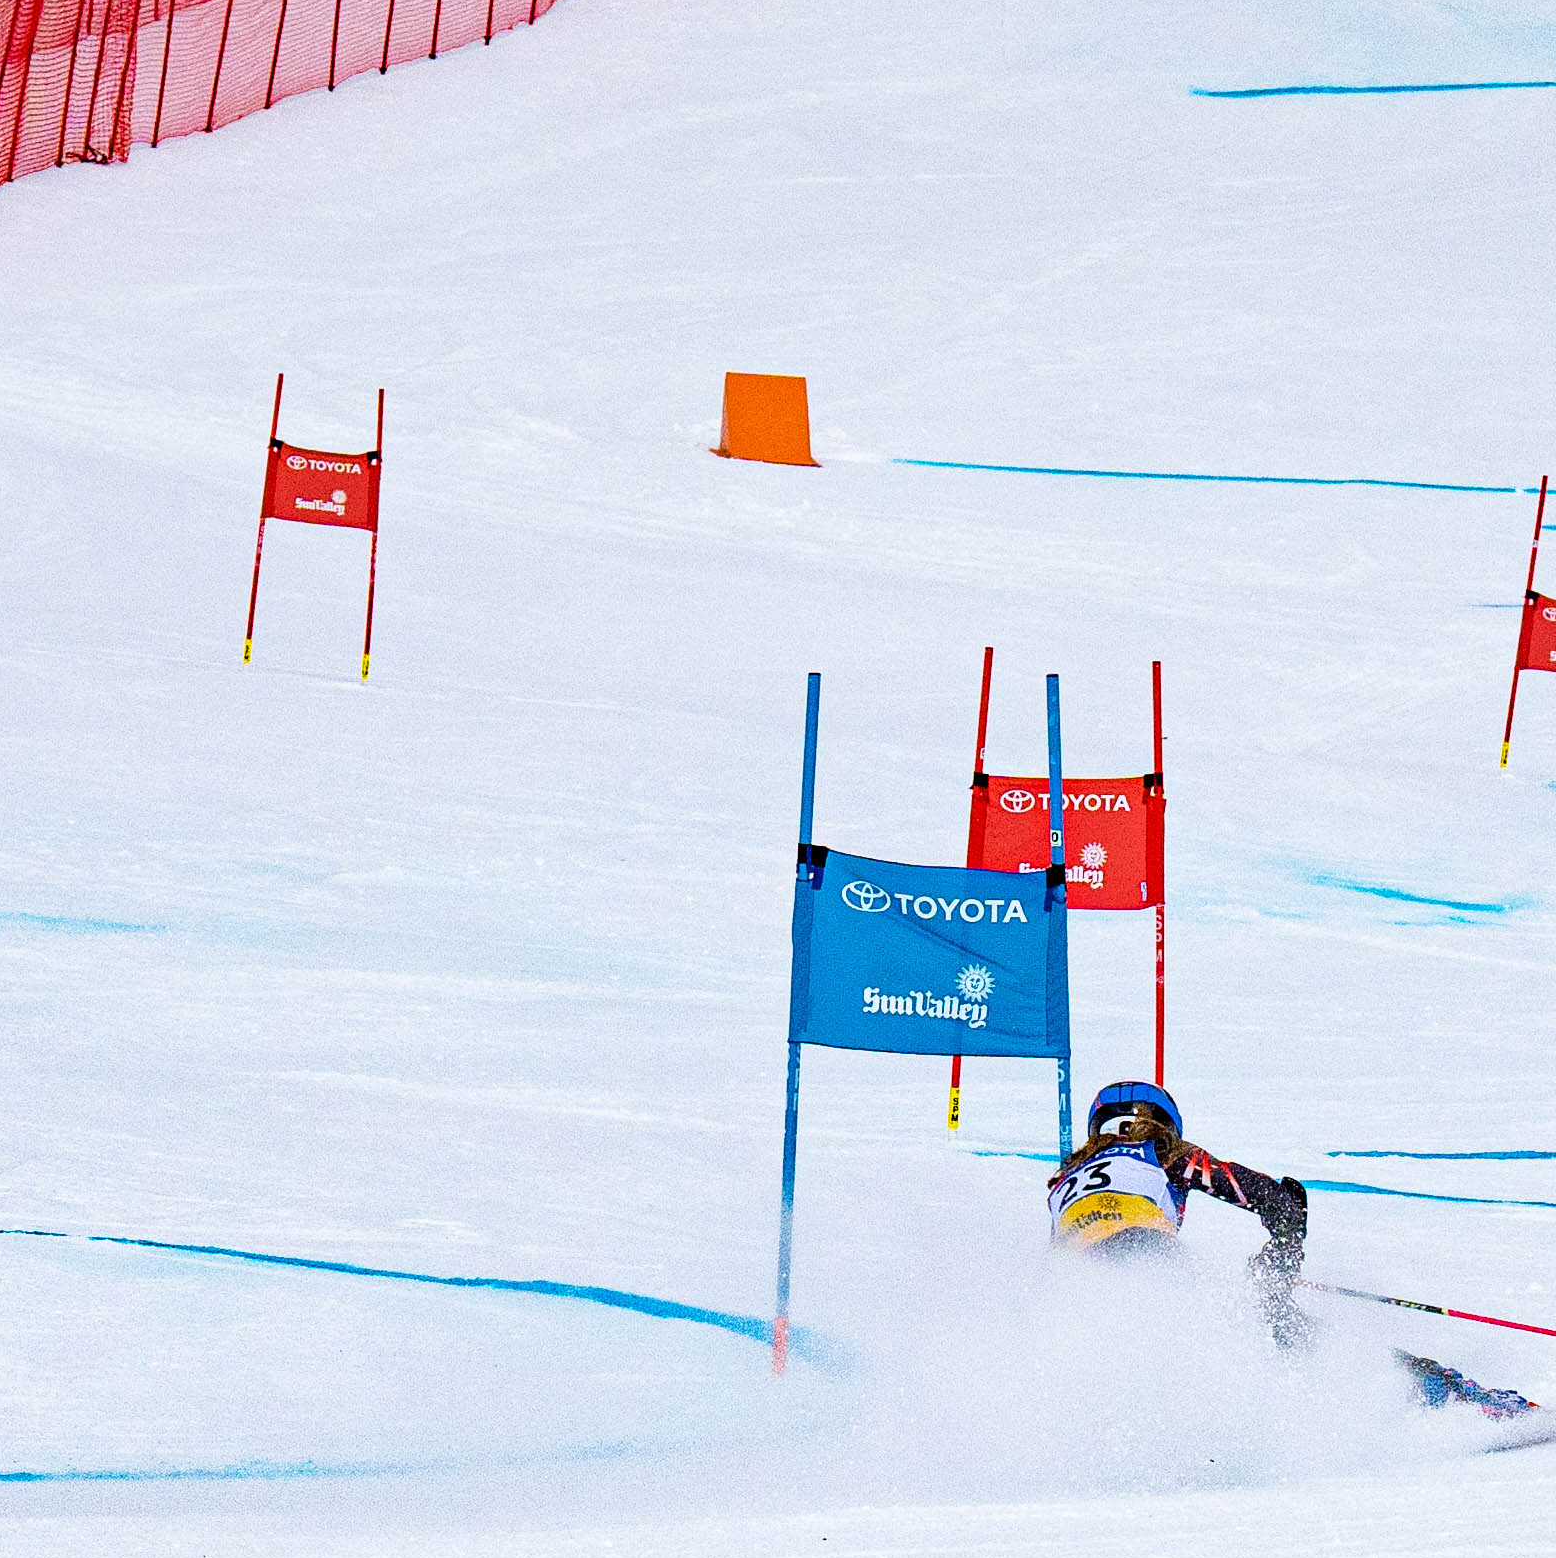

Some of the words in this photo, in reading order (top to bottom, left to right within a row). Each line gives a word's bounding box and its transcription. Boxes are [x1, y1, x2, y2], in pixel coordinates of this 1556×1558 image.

[308, 459, 362, 475] TOYOTA
[894, 893, 1028, 925] TOYOTA
[1056, 1161, 1112, 1213] 23
